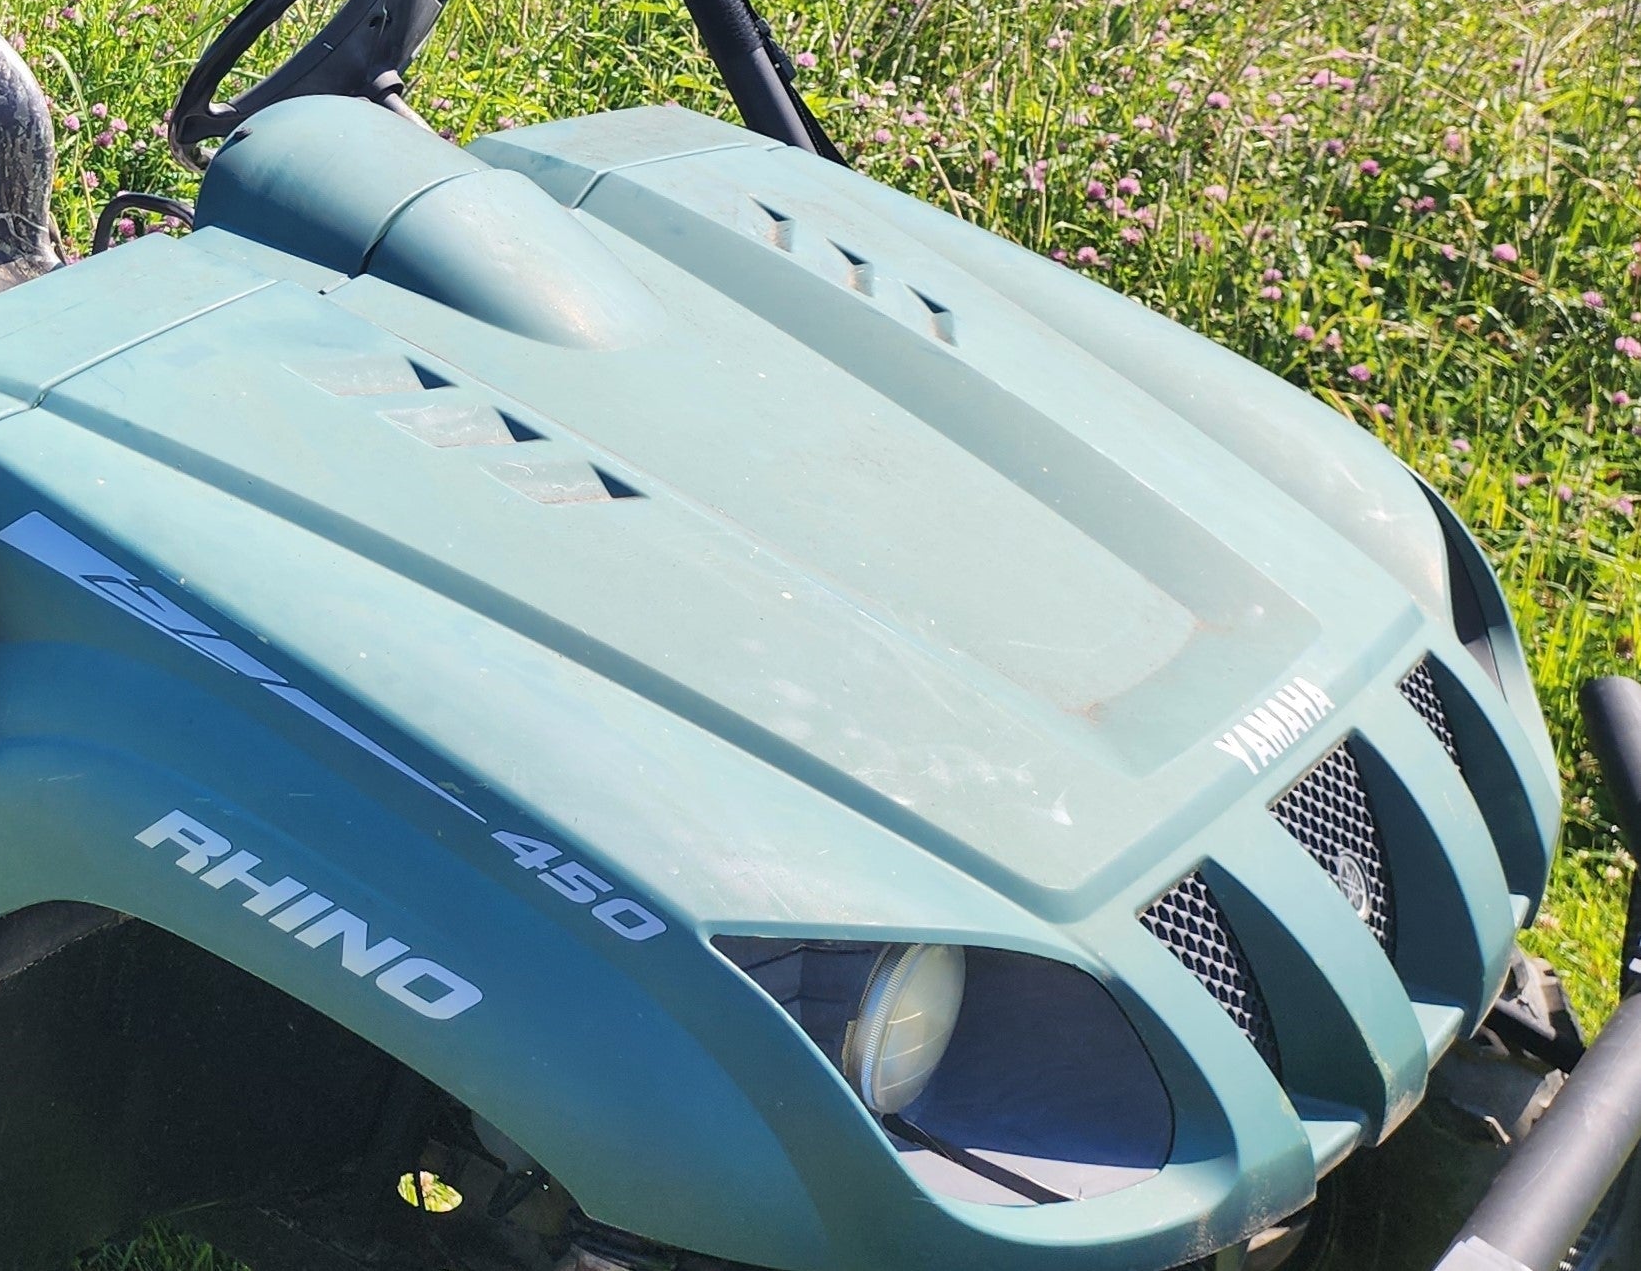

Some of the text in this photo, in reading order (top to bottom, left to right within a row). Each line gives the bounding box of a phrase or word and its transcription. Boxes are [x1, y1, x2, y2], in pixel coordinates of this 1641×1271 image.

[1213, 676, 1336, 776] YAMAHA
[134, 808, 483, 1020] RHINO
[491, 829, 668, 942] 450
